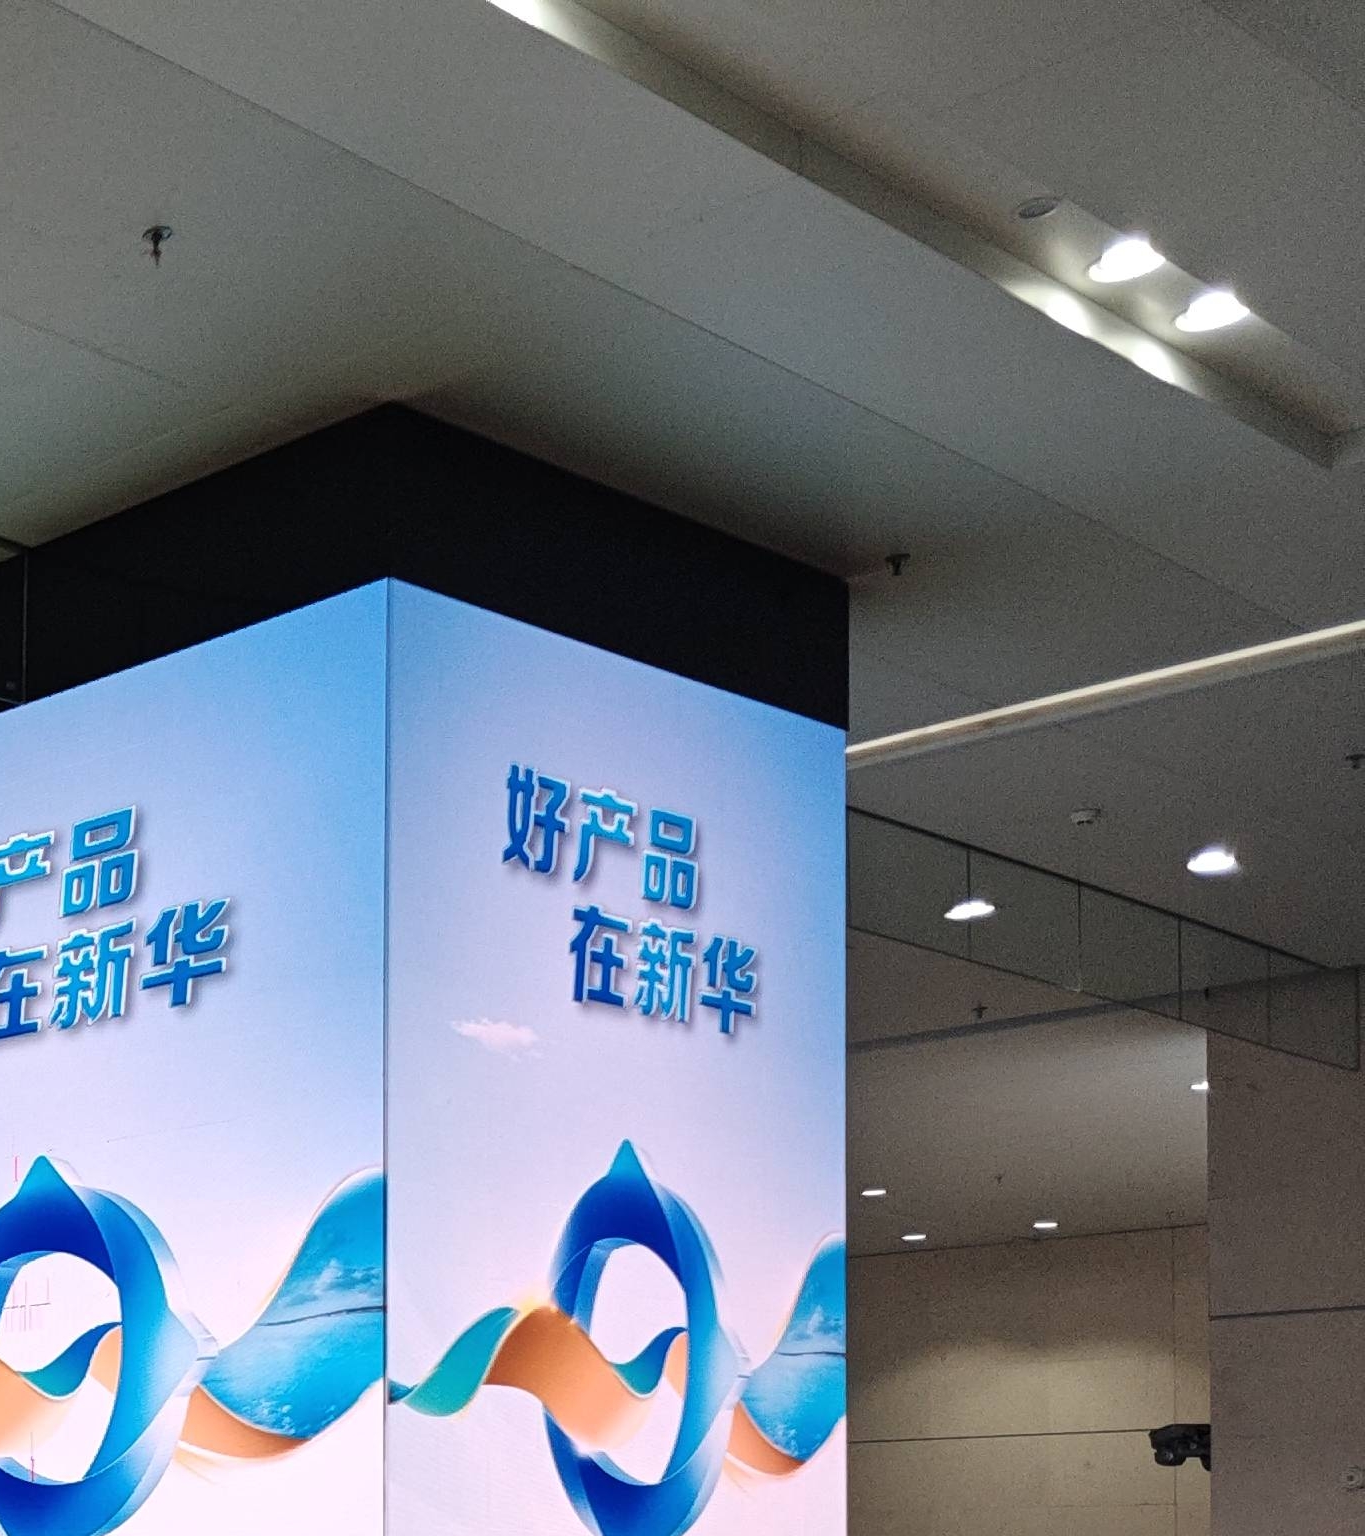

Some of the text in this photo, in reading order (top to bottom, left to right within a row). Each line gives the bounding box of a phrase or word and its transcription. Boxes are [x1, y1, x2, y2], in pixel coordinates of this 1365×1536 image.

[502, 760, 698, 911] 好产品
[570, 904, 757, 1034] 在新华
